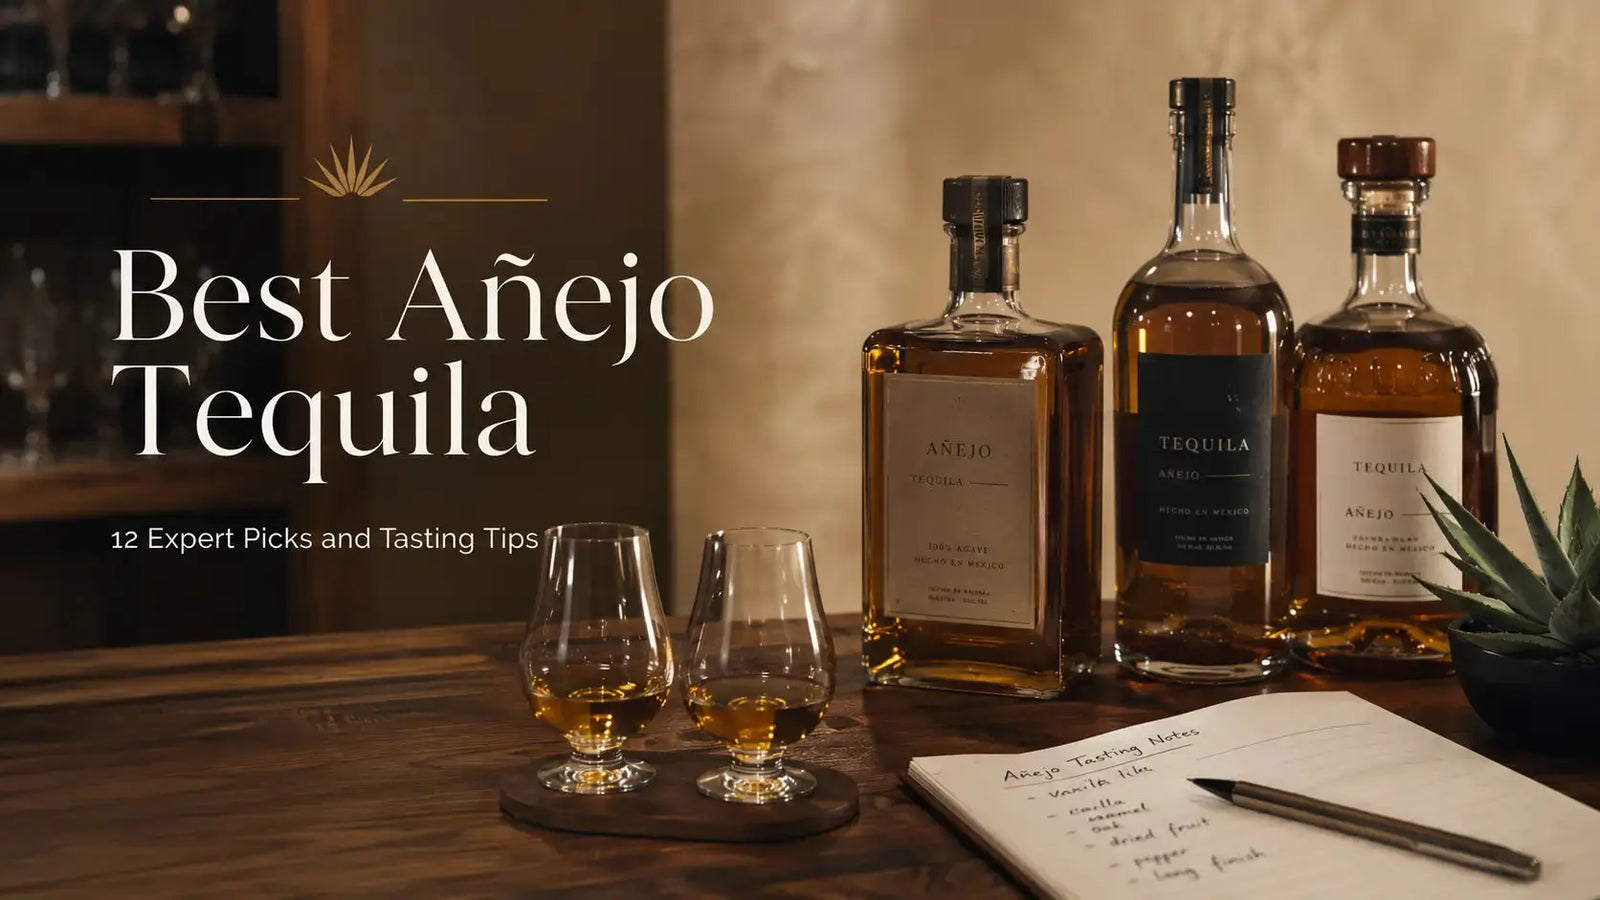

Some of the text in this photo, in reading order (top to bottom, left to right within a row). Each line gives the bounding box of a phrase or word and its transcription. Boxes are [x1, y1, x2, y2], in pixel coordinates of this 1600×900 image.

[926, 439, 992, 460] AÑEJO
[1159, 435, 1250, 454] TEQUILA
[1159, 469, 1200, 481] AÑEJO
[1353, 461, 1428, 475] TEQUILA
[911, 474, 963, 487] TEQUILA
[1159, 506, 1250, 516] HECHO EN MEXICO
[1345, 506, 1394, 520] AÑEJO
[956, 544, 989, 554] AGAVE
[914, 556, 1005, 570] HECHO EN MEXICO
[1004, 728, 1200, 782] Añejo Tasting Notes
[1110, 817, 1210, 846] dried fruit
[1134, 849, 1188, 869] pepper
